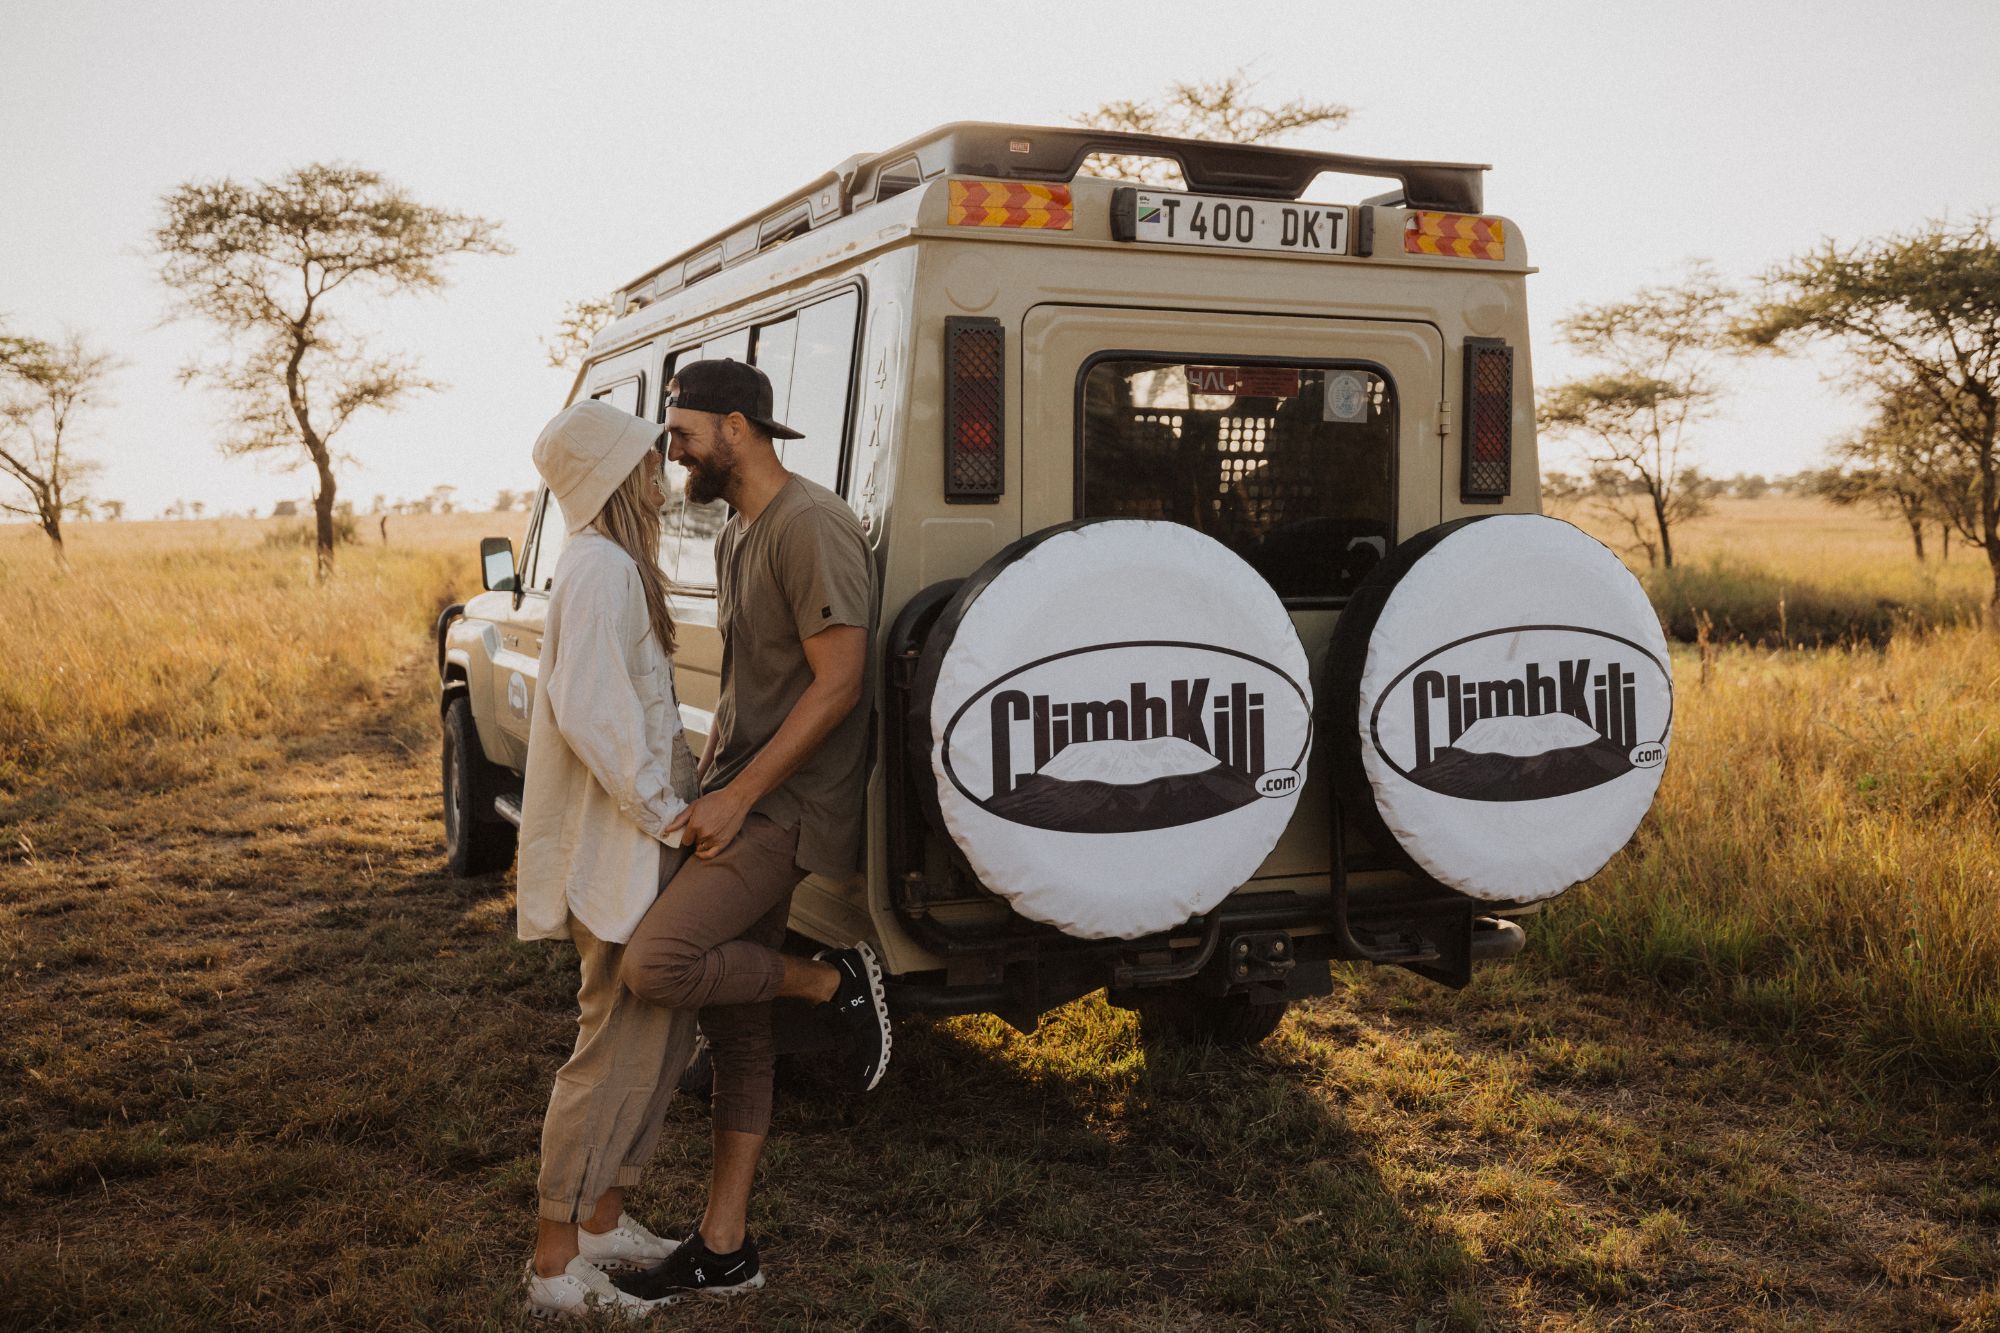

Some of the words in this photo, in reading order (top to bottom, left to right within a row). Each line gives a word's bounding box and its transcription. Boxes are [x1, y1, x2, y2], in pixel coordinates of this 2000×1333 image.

[1162, 198, 1181, 238] T
[1189, 201, 1254, 242] 400
[1280, 207, 1344, 249] DKT
[1261, 775, 1296, 793] .com
